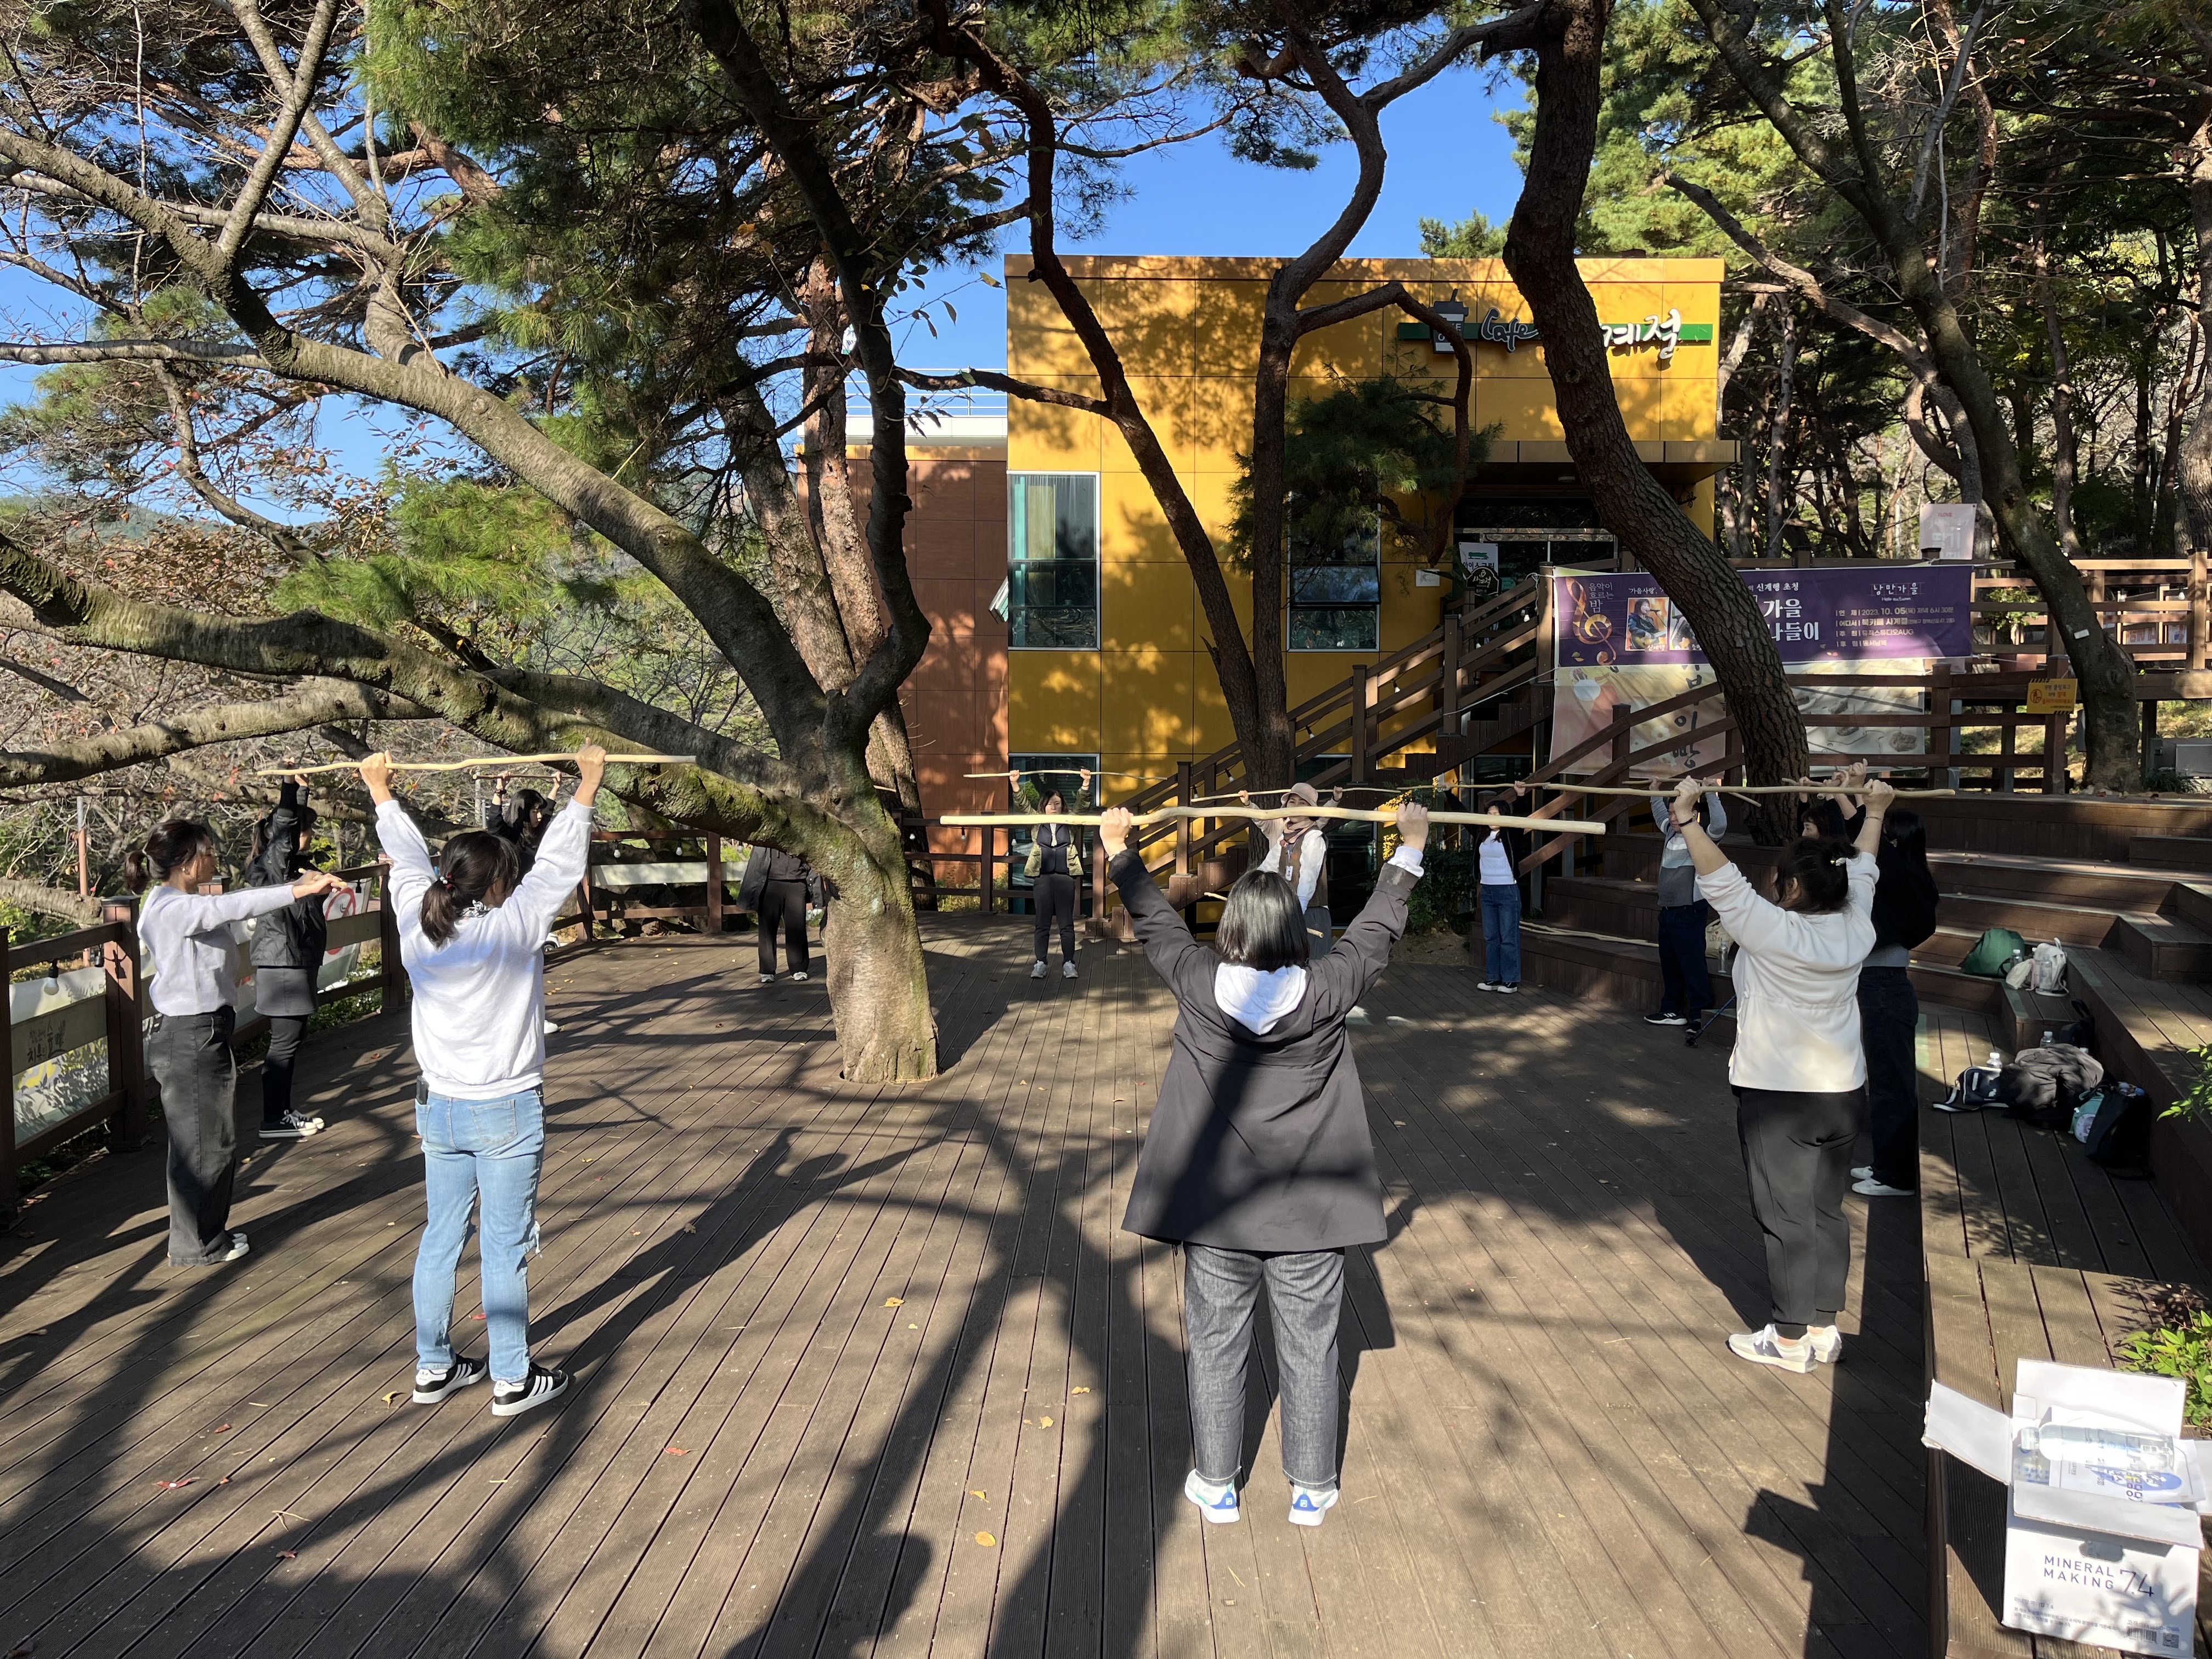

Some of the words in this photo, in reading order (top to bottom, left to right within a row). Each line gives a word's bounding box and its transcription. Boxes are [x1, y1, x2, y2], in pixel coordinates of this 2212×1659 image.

[1481, 307, 1539, 352] Cafe
[1598, 308, 1681, 359] 계절
[1589, 582, 1613, 591] 음악이
[1589, 591, 1614, 600] 흐르는
[1590, 600, 1603, 613] 밤
[1763, 599, 1802, 618] 가을
[2044, 1555, 2114, 1578] MINERAL
[2044, 1567, 2114, 1589] MAKING
[2119, 1568, 2155, 1598] 7.4
